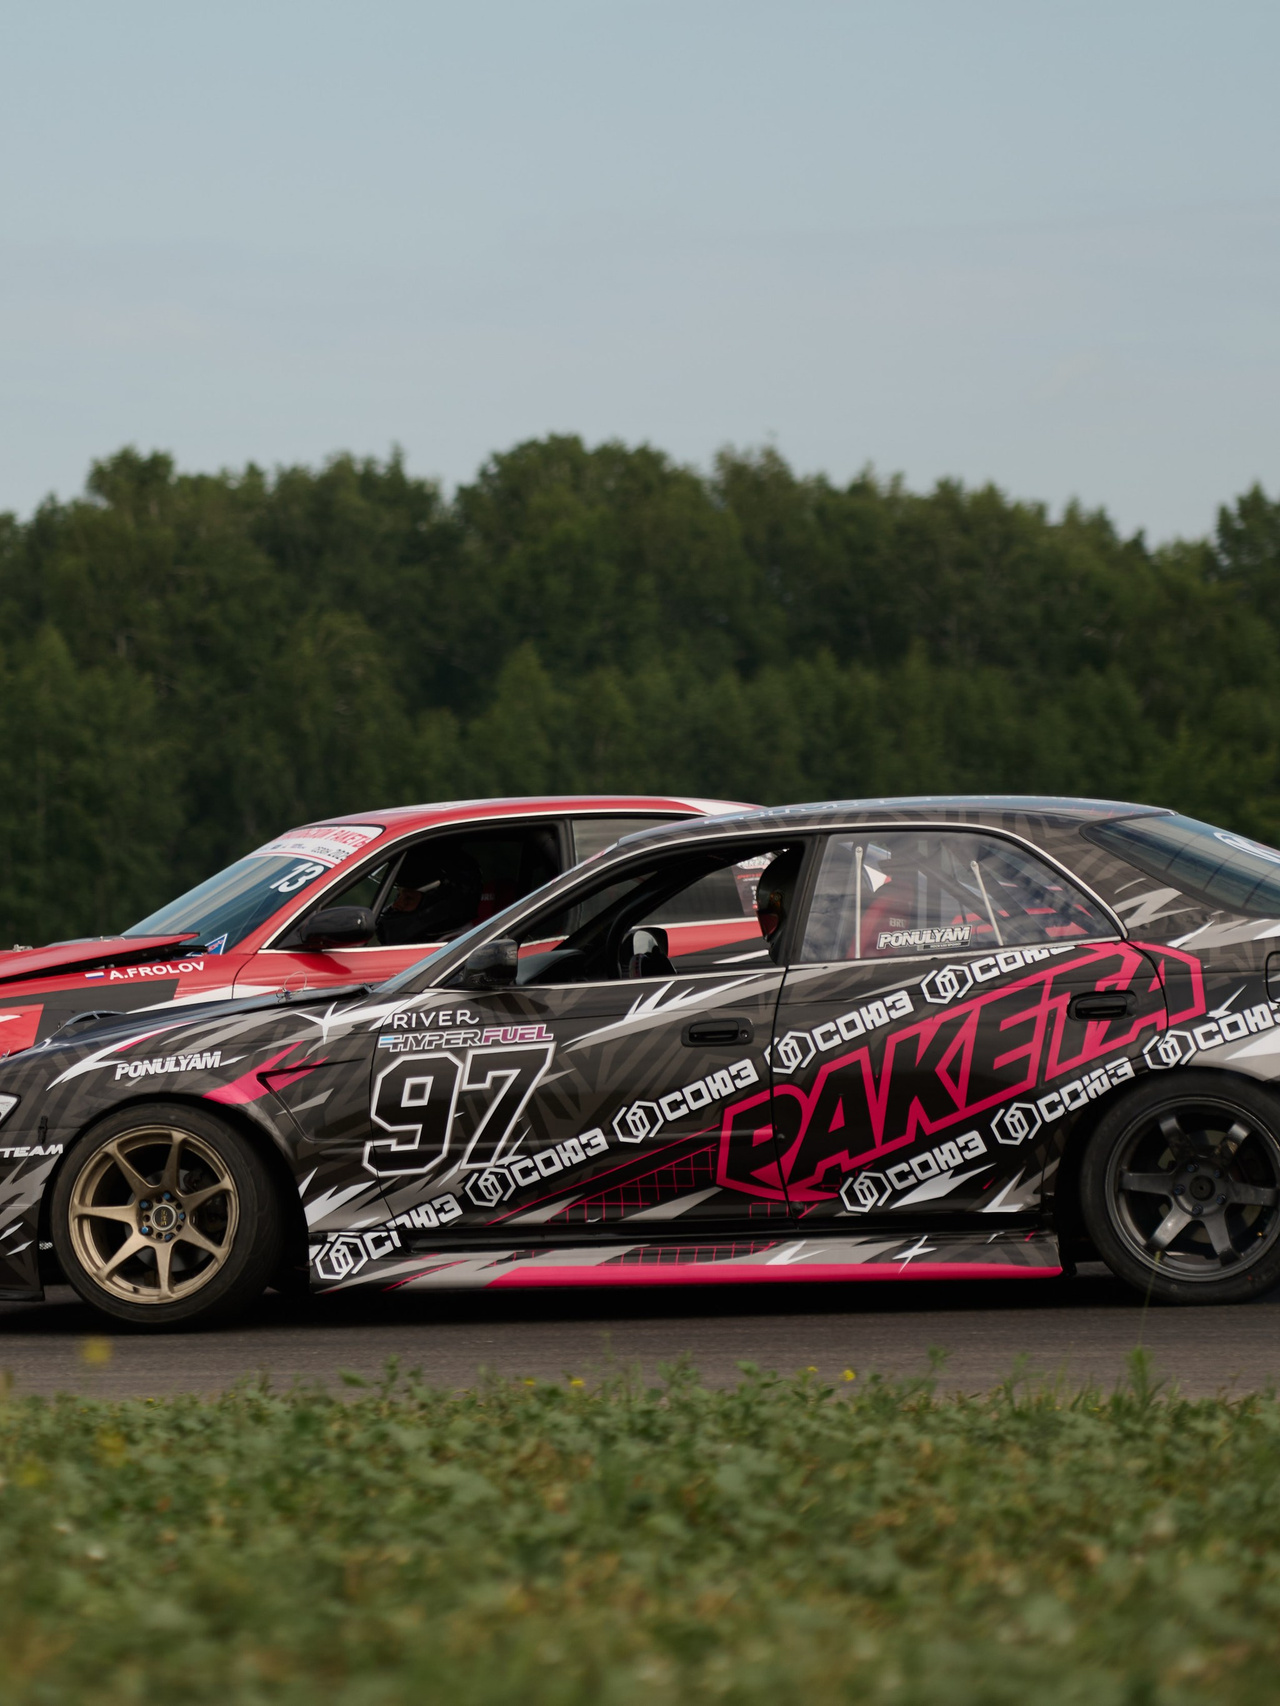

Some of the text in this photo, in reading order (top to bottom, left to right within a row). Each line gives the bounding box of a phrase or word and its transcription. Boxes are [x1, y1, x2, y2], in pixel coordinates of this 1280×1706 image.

[270, 862, 324, 893] 13
[878, 926, 971, 949] PONULYAM
[109, 961, 205, 980] A.FROLOV
[970, 945, 1076, 983] СОЮ
[393, 1010, 480, 1029] RIVER
[811, 990, 915, 1052] СОЮЗ
[114, 1050, 222, 1081] PONULYAM
[660, 1059, 760, 1122] СОЮЗ
[361, 1042, 557, 1178] 97
[511, 1127, 610, 1187] СОЮЗ
[887, 1129, 988, 1191] СОЮЗ
